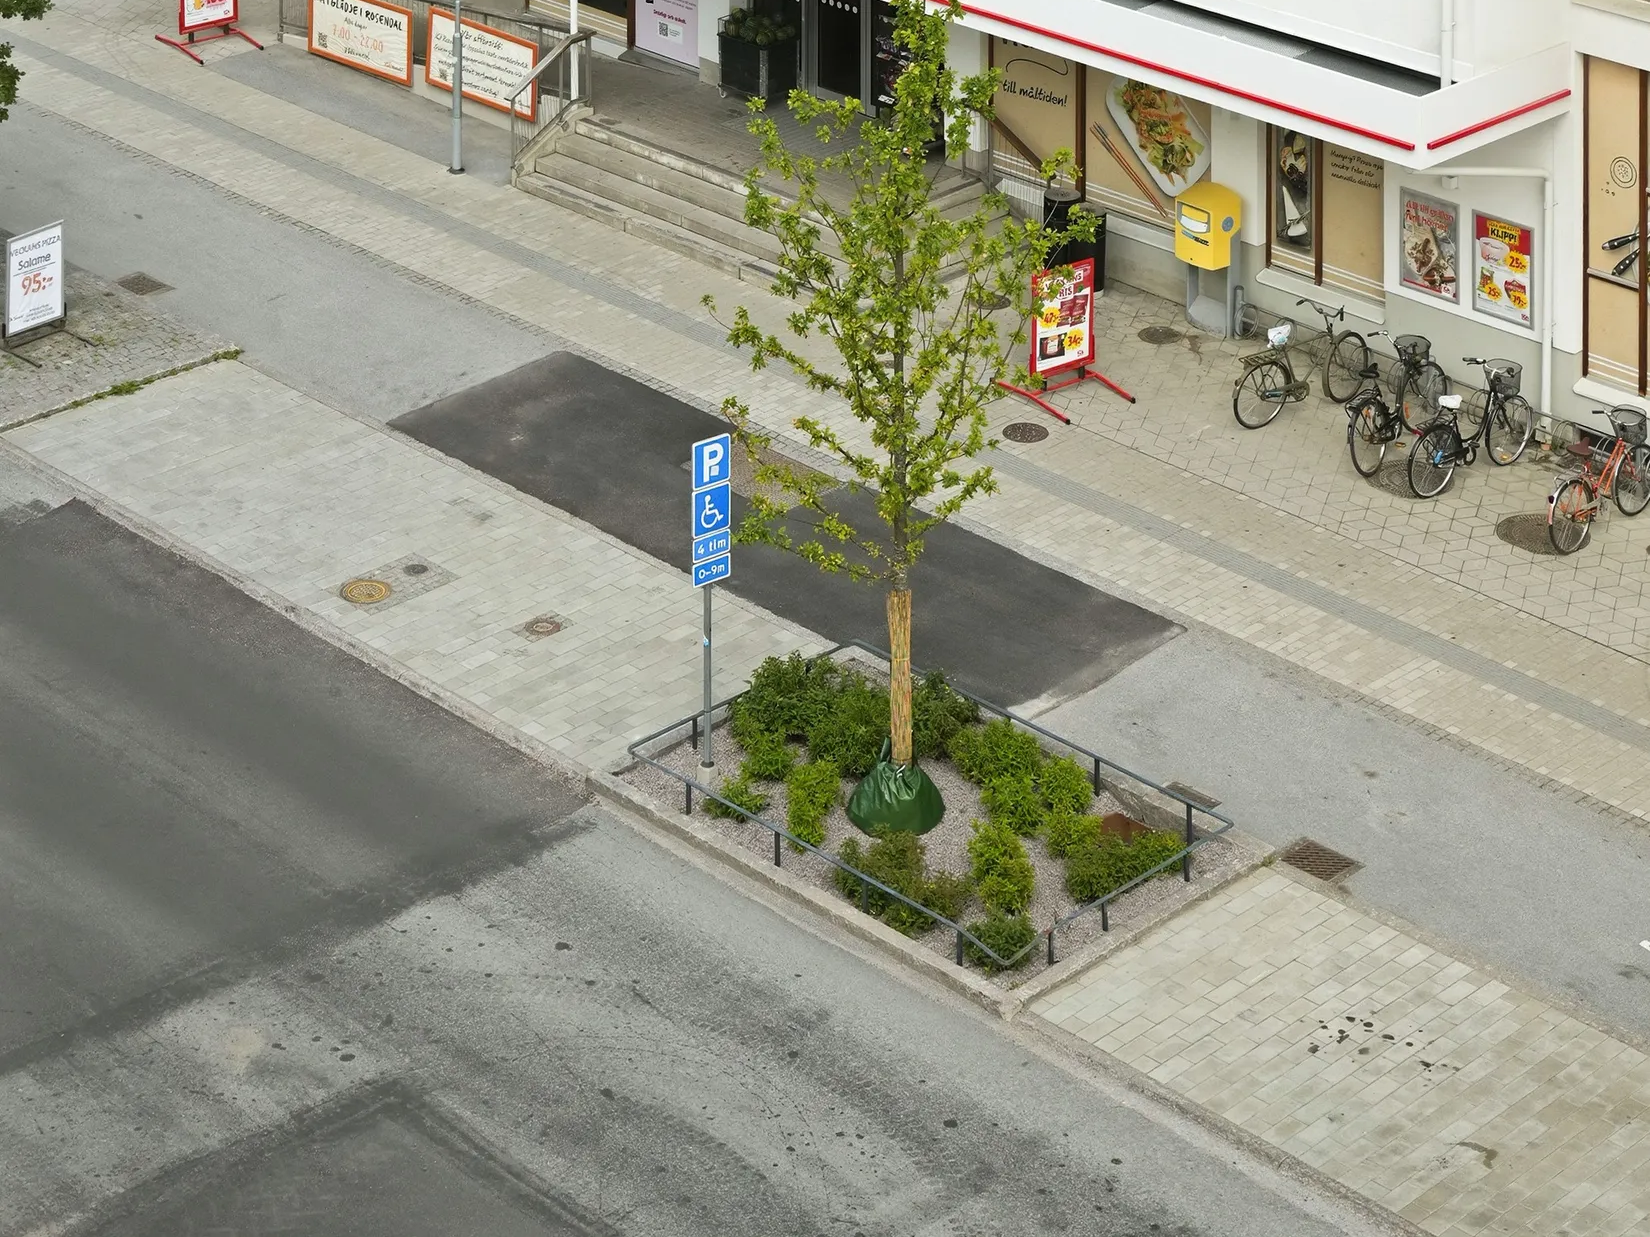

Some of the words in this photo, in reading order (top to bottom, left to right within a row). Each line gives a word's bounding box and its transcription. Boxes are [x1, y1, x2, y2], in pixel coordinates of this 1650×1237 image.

[365, 10, 403, 31] ROSENDAL
[1002, 78, 1017, 94] till
[1019, 86, 1068, 107] måltiden!
[41, 234, 62, 247] PIZZA
[1490, 227, 1518, 244] KLIPP!
[703, 442, 724, 483] P
[697, 543, 705, 556] 4
[708, 539, 727, 552] tim
[698, 563, 725, 580] 0-9m
